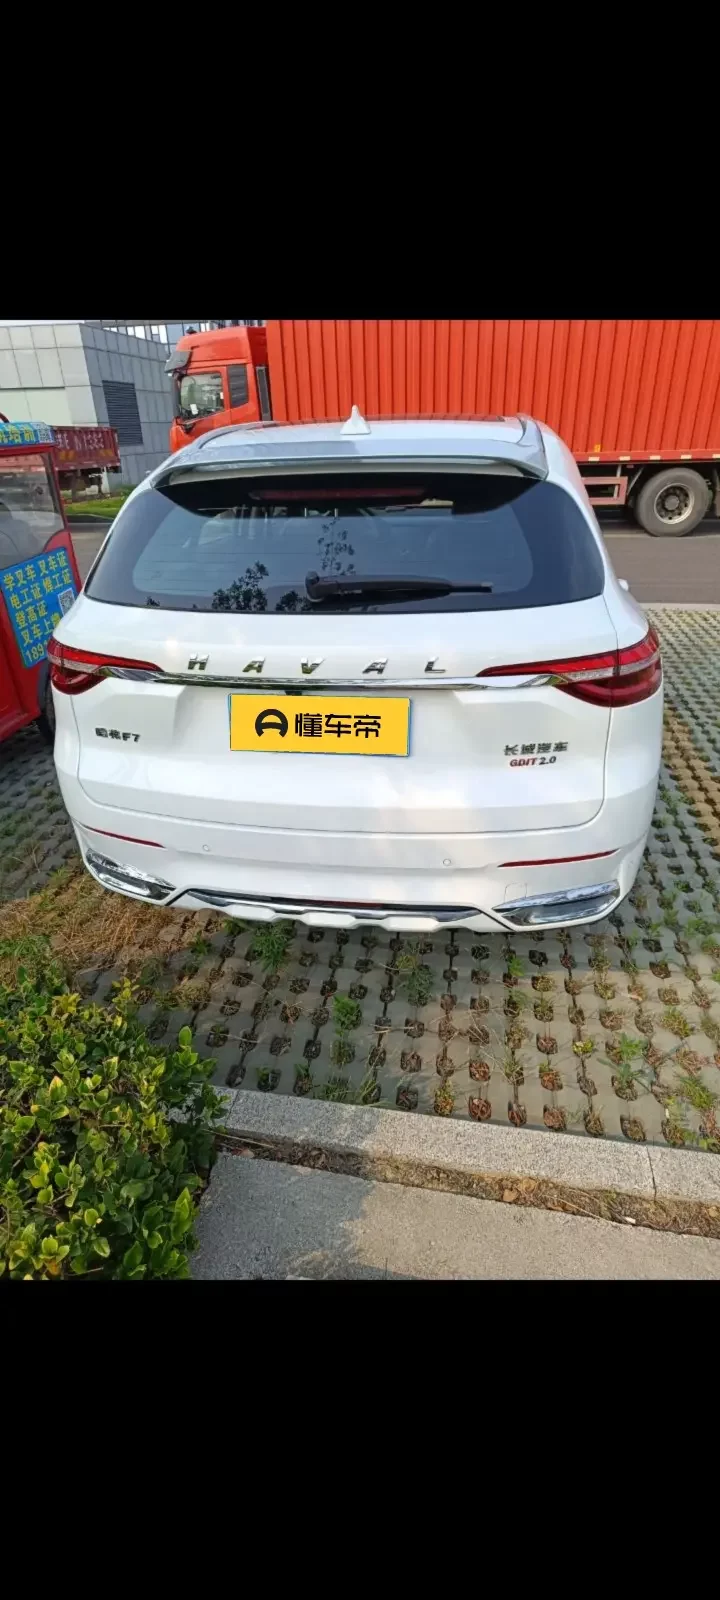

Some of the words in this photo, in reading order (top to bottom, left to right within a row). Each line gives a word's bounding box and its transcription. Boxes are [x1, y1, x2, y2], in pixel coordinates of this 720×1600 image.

[4, 564, 36, 592] 学叉车
[38, 551, 68, 577] 叉车证
[10, 582, 42, 610] 电工证
[16, 600, 48, 629] 登高证
[187, 653, 447, 676] HAVAL
[503, 741, 569, 757] 长城汽车
[509, 757, 537, 767] GDIT
[538, 755, 557, 766] 2.0
